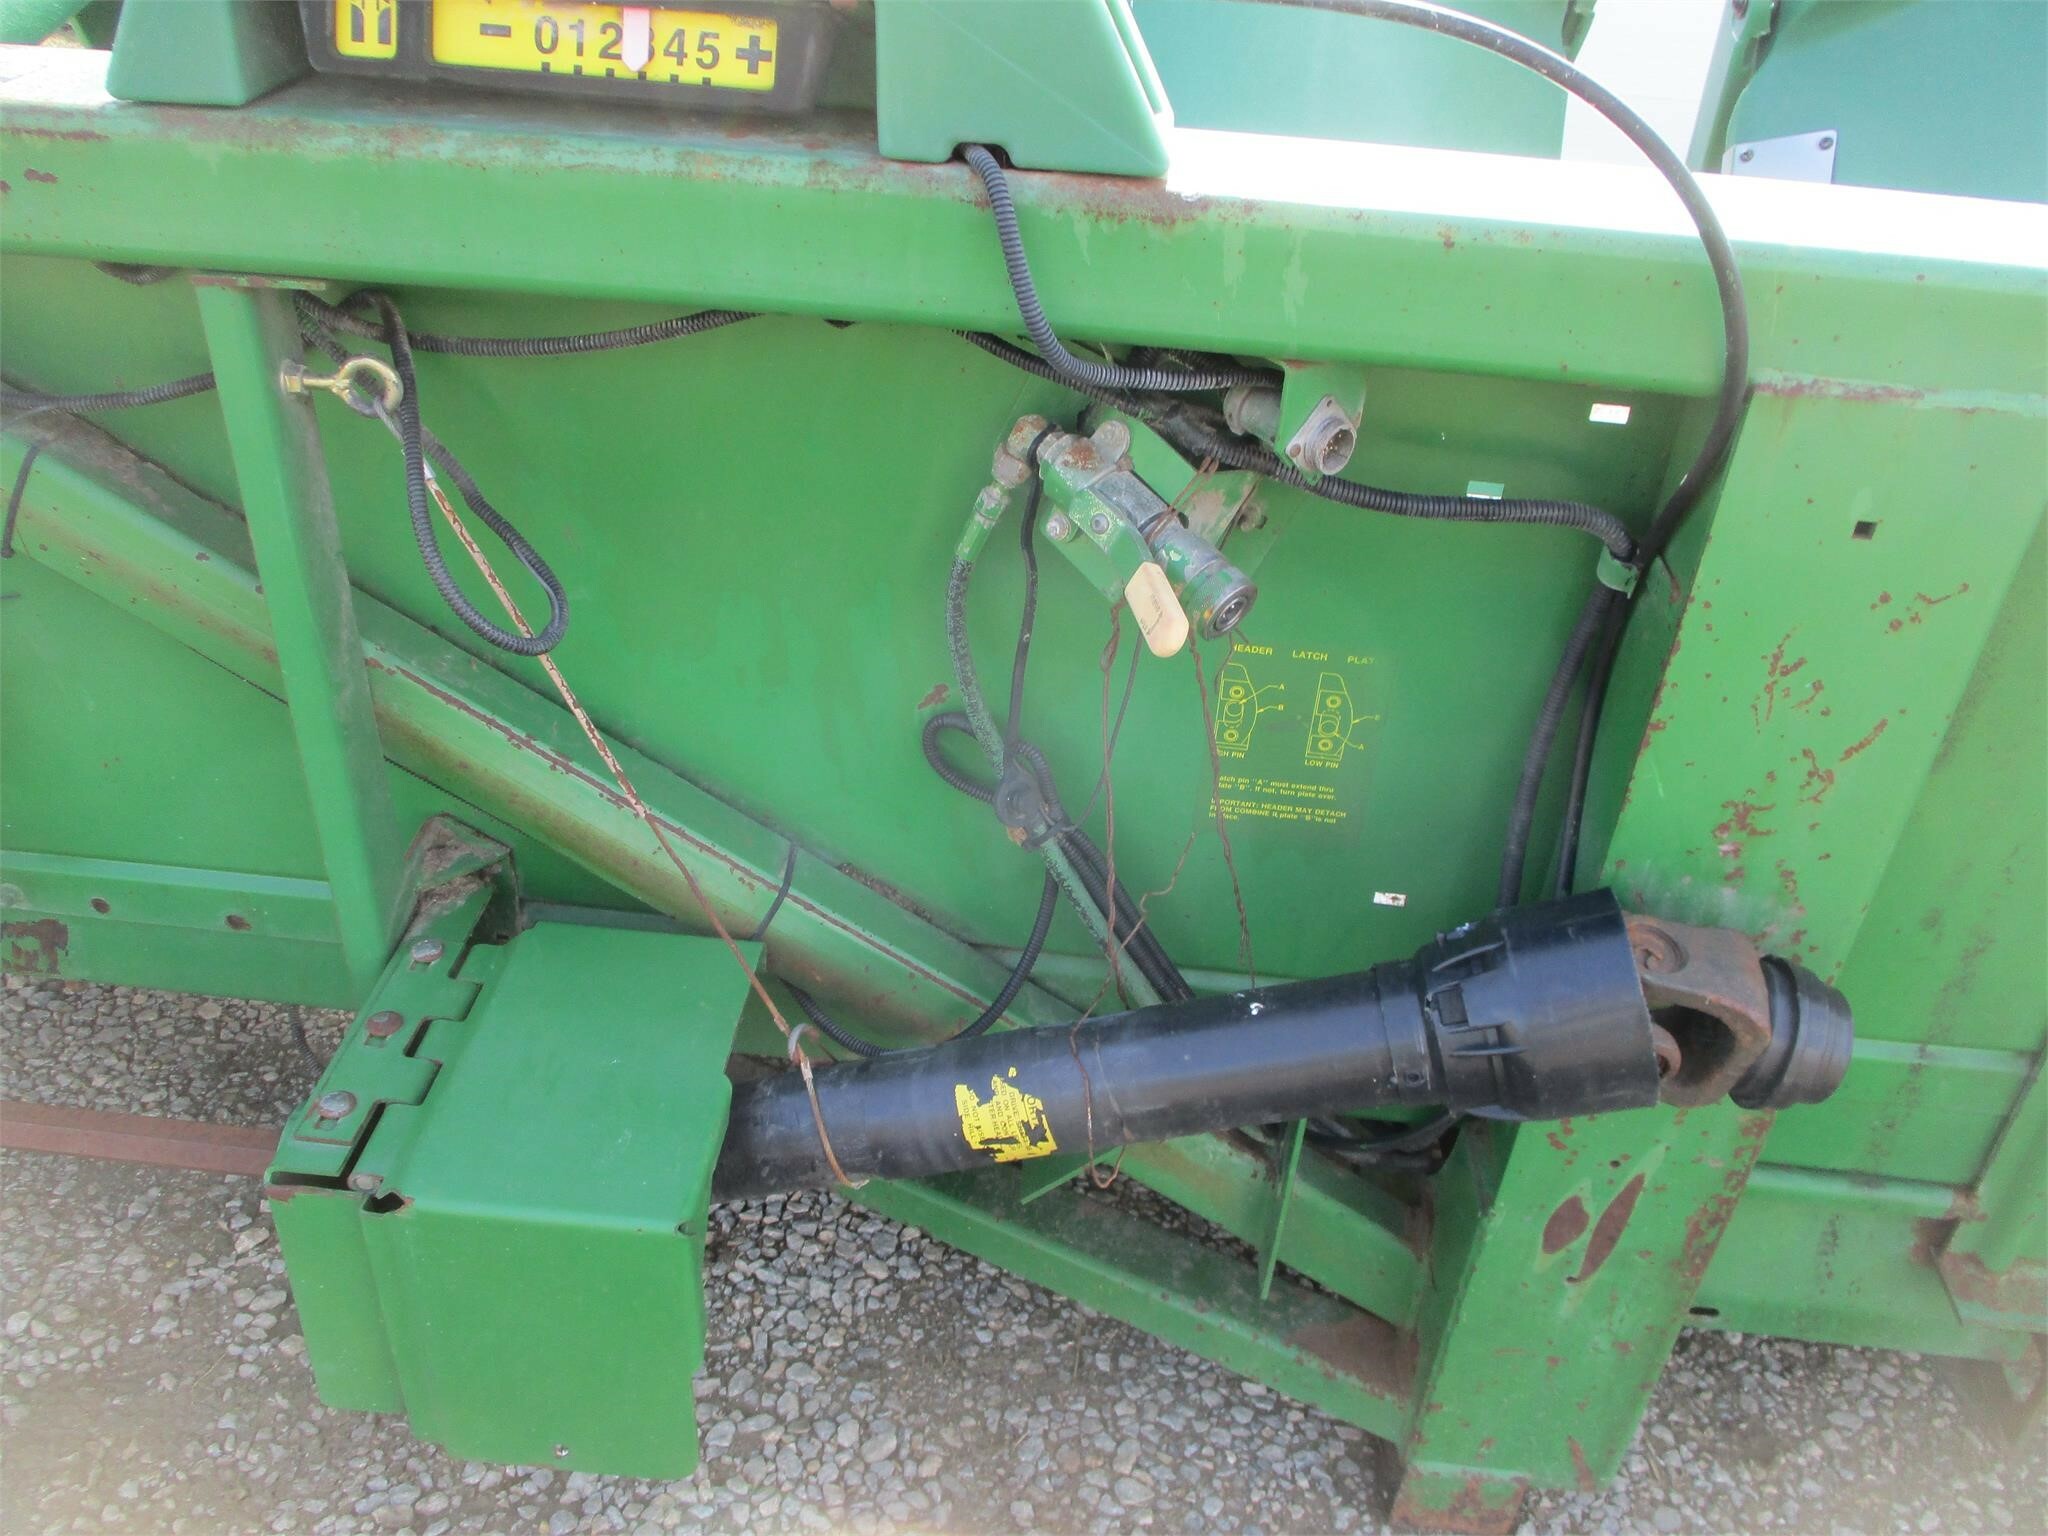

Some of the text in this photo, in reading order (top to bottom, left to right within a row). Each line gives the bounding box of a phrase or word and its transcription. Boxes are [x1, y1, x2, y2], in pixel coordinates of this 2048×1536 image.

[1292, 650, 1328, 662] LATCH
[1304, 759, 1323, 767] LOW
[1219, 775, 1236, 783] atch
[1291, 783, 1317, 791] extend
[1297, 790, 1316, 799] plate
[1234, 807, 1270, 817] COMBINE
[1261, 803, 1293, 812] HEADER
[1295, 806, 1314, 815] MAY
[1314, 809, 1347, 818] DETACH
